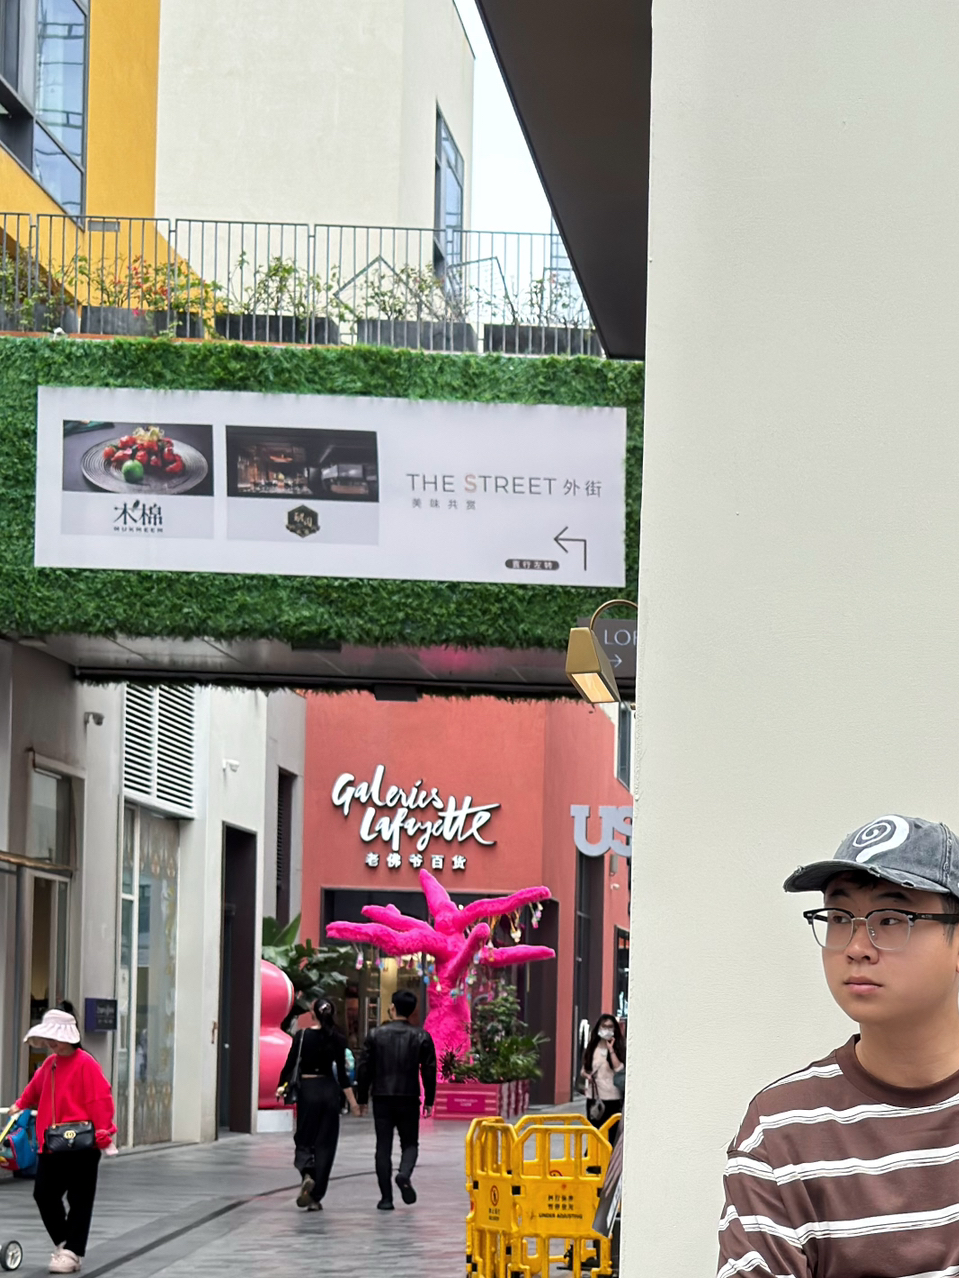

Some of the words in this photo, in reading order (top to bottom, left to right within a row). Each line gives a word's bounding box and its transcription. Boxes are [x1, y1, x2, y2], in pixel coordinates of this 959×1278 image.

[406, 473, 455, 492] THE
[464, 474, 557, 496] STREET
[562, 479, 602, 498] 外街
[113, 500, 163, 526] 木棉
[604, 629, 638, 646] LO
[331, 764, 444, 816] Galeries
[359, 795, 501, 852] Lafayette
[365, 852, 467, 870] 老佛爷百货
